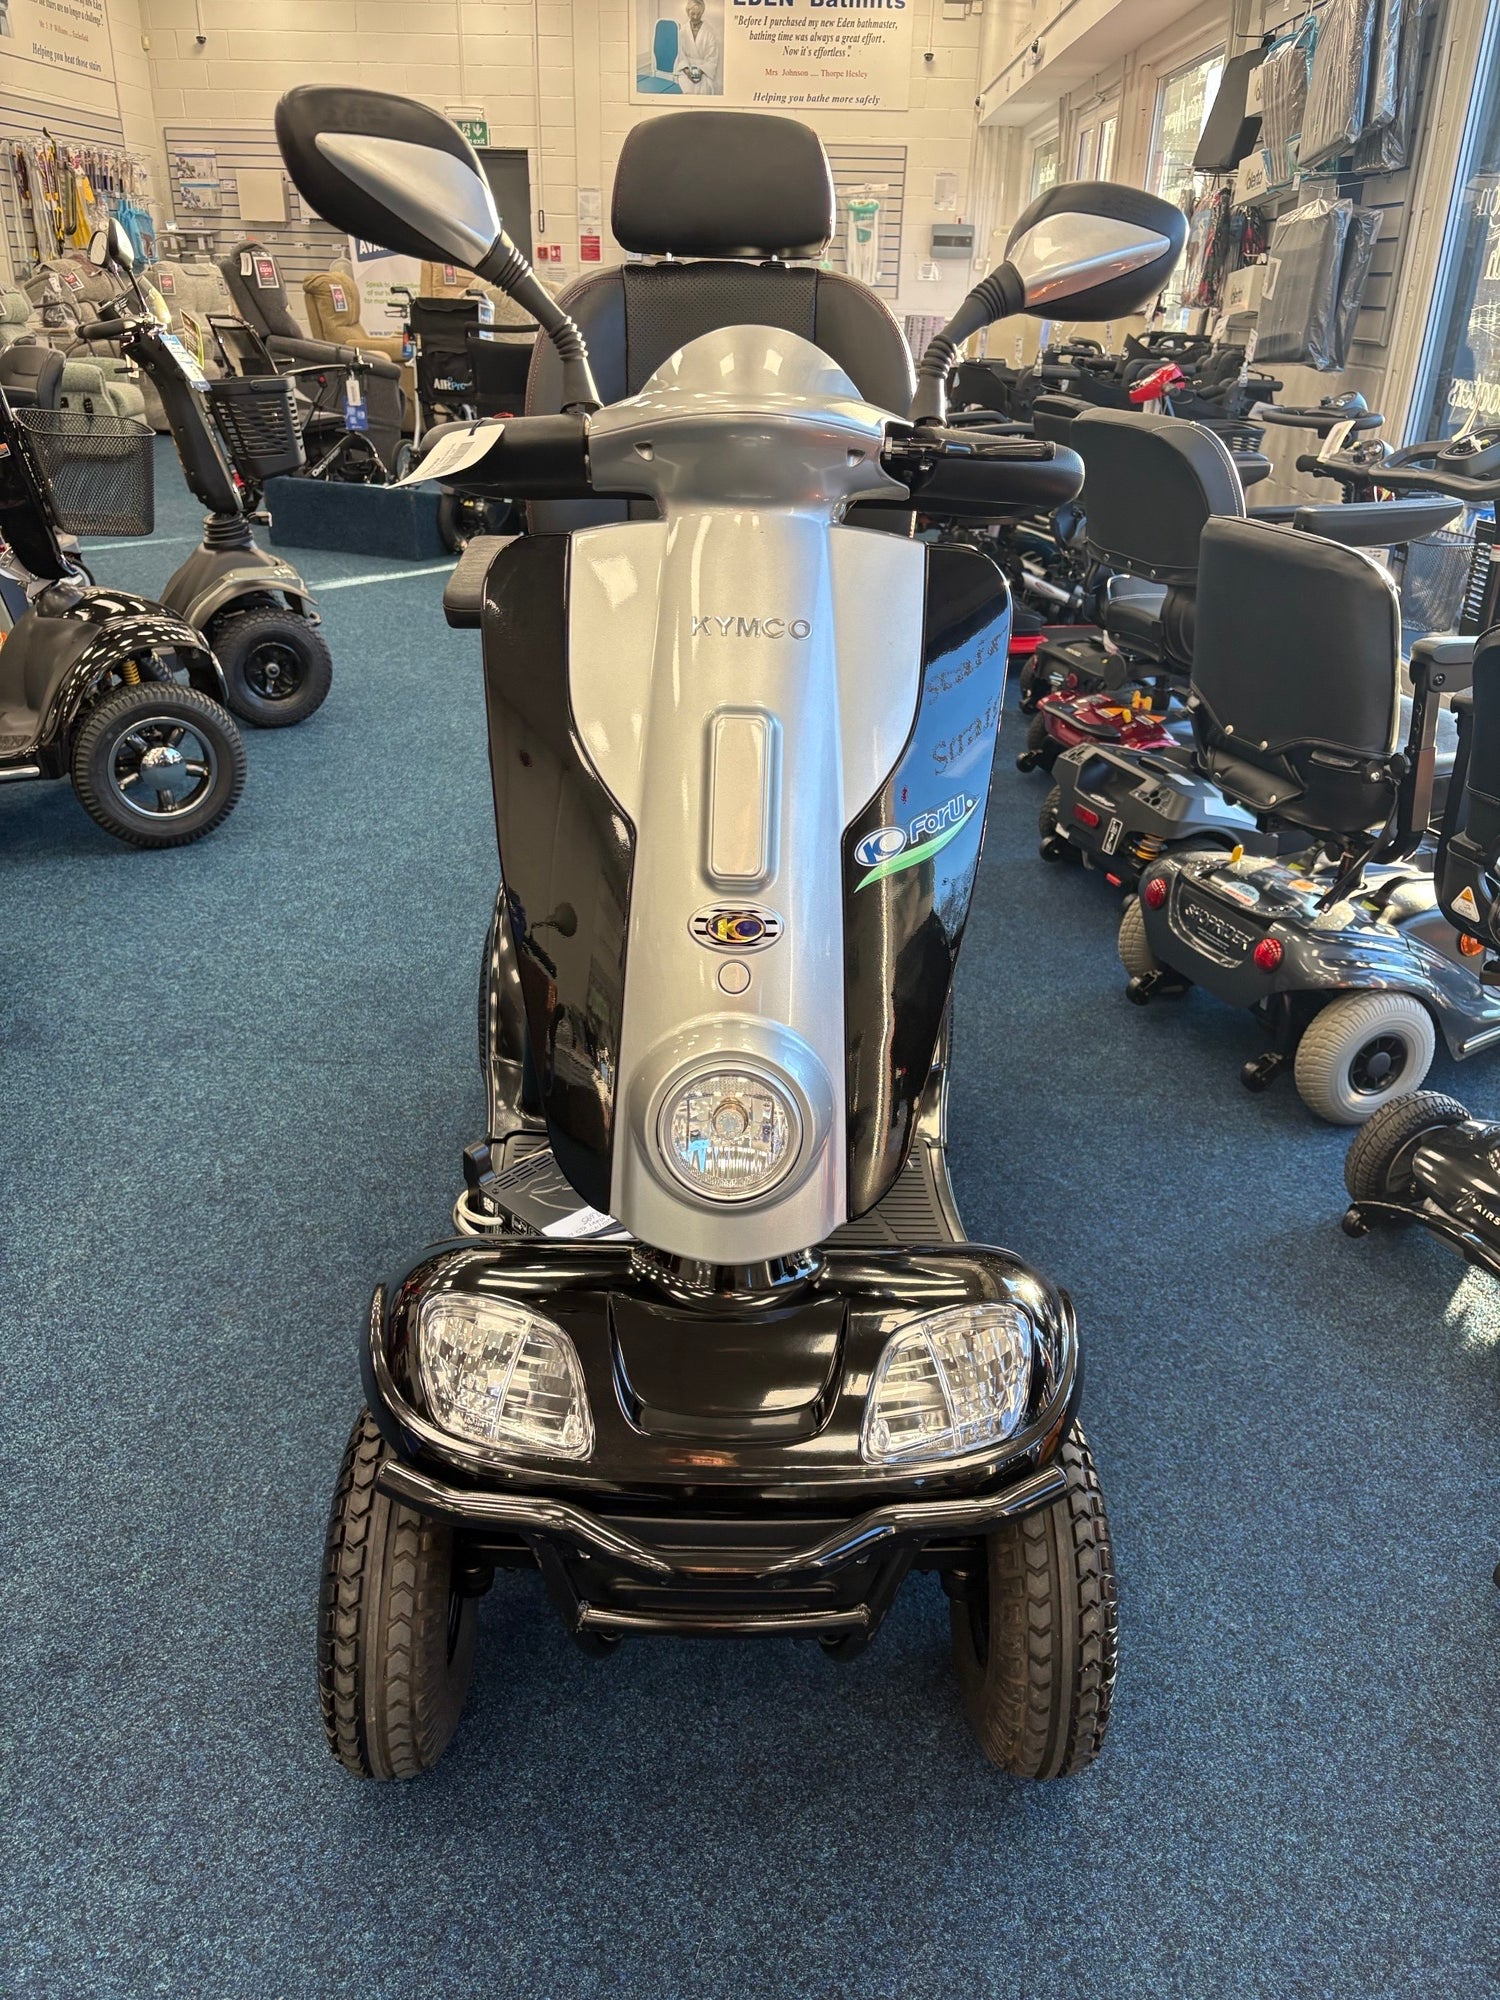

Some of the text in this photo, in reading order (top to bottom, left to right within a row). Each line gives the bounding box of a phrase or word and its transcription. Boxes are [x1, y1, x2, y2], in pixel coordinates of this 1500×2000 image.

[769, 16, 807, 29] purchased
[807, 19, 819, 30] my
[820, 19, 835, 28] new
[836, 17, 855, 28] Eden
[749, 30, 776, 43] bathing
[777, 31, 793, 41] time
[794, 33, 808, 42] was
[810, 32, 834, 45] always
[841, 34, 861, 45] great
[782, 45, 799, 56] Now
[765, 68, 868, 79] Mrs Johnson Thorpe Hesley
[753, 92, 880, 105] Helping you bathe more safely
[688, 615, 814, 641] KYMCO
